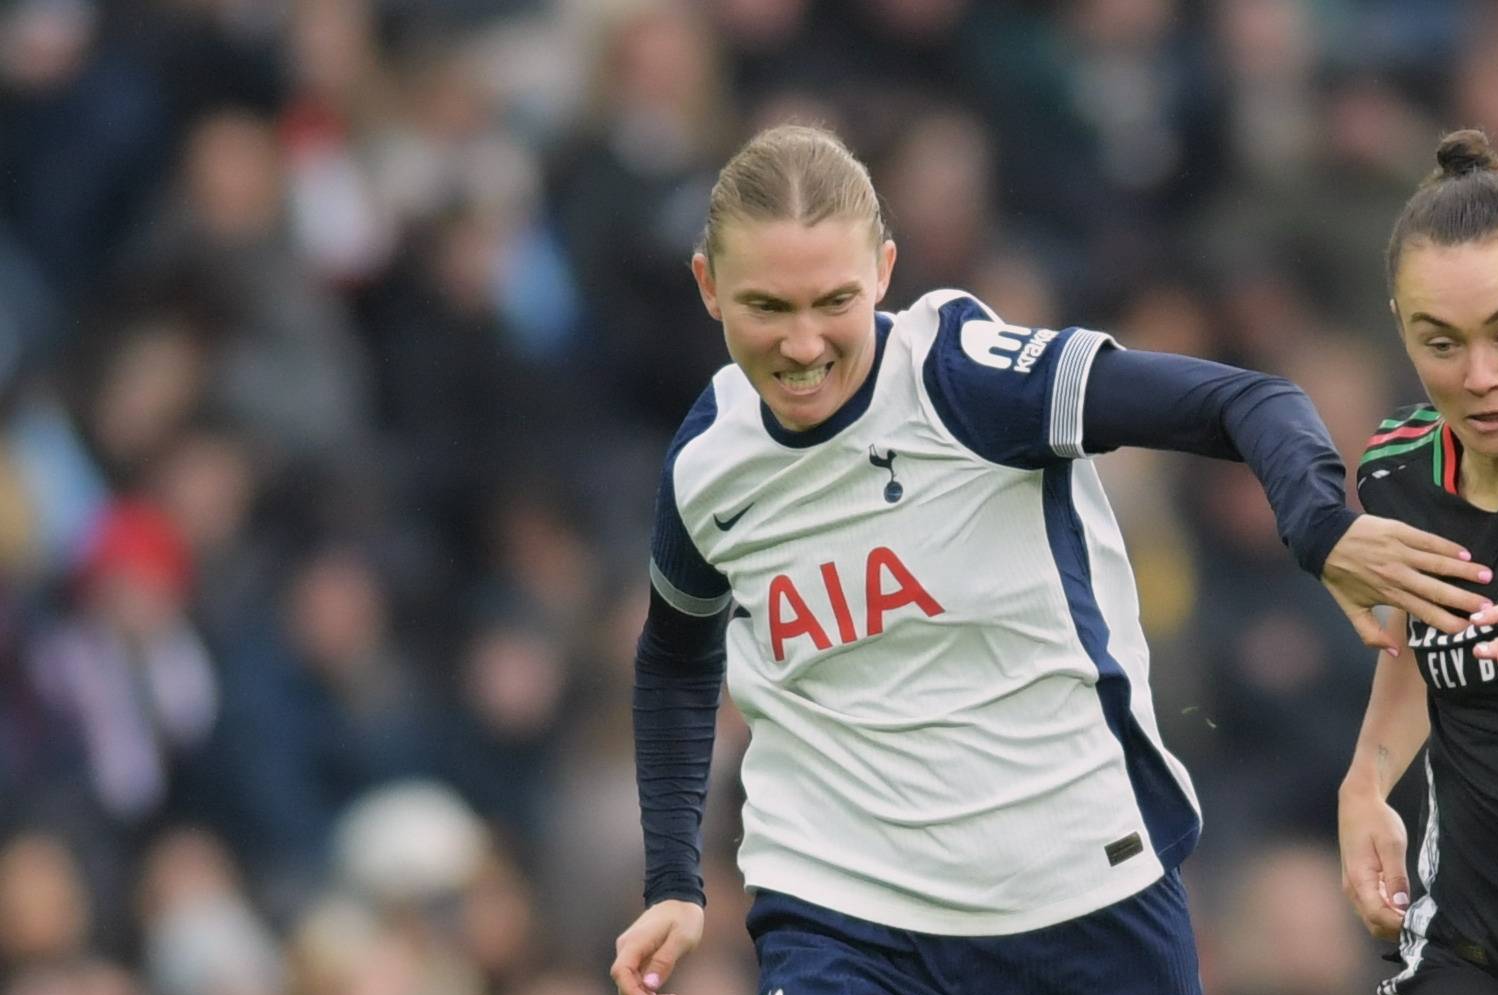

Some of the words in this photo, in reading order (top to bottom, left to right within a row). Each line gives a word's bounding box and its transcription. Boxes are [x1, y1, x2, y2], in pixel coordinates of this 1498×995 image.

[1013, 328, 1060, 373] krake
[768, 546, 946, 662] AIA
[1427, 647, 1467, 689] FLY
